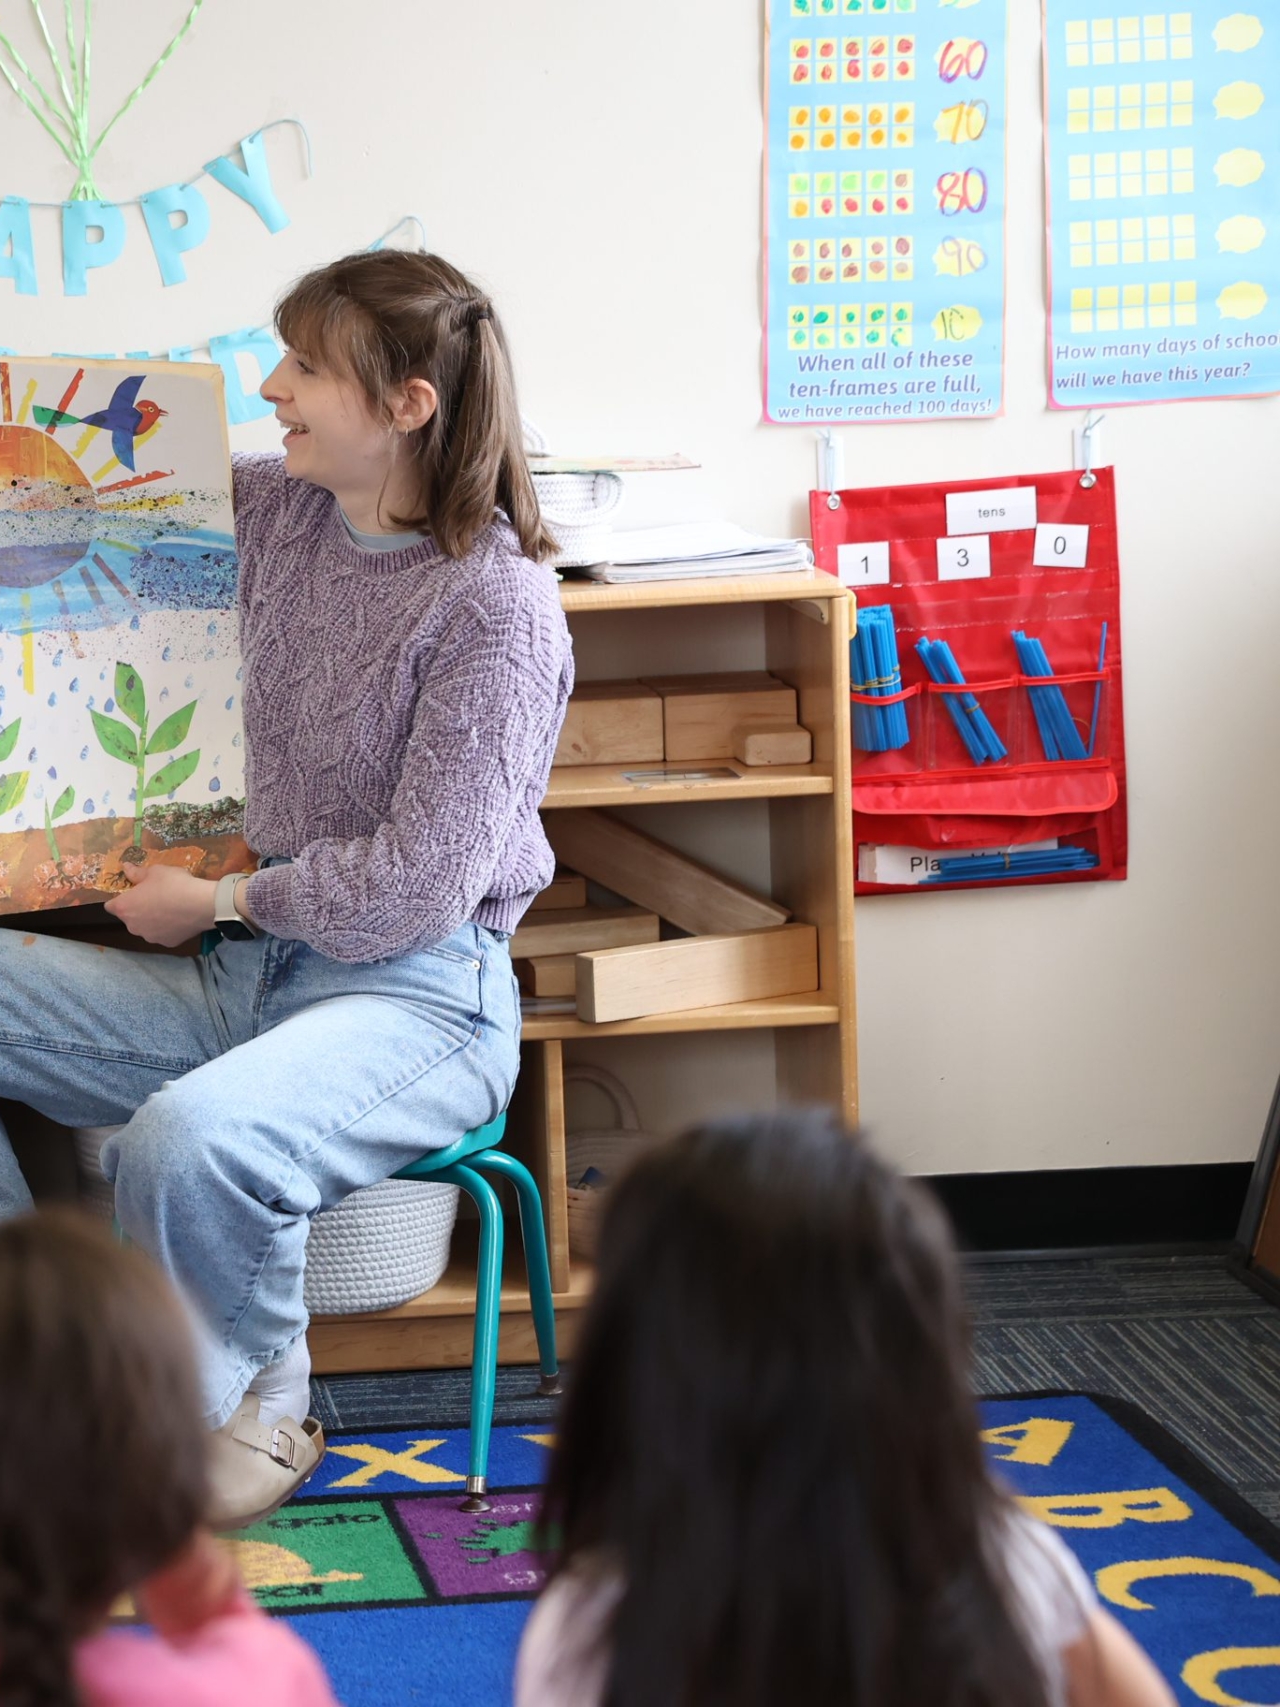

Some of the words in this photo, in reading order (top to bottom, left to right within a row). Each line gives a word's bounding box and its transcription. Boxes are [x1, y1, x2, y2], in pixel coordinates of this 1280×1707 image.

[938, 40, 988, 83] 60
[941, 98, 989, 145] 70
[937, 167, 988, 216] 80
[942, 235, 988, 277] 90
[798, 354, 855, 372] When
[861, 352, 886, 370] all
[893, 351, 913, 369] of
[919, 351, 973, 368] these
[1056, 346, 1097, 360] How
[1102, 343, 1151, 358] many
[1157, 338, 1196, 356] days
[1203, 334, 1221, 350] of
[1226, 332, 1280, 349] schoo
[789, 379, 898, 398] ten-frames
[904, 380, 936, 394] are
[943, 374, 981, 394] full,
[1056, 373, 1086, 388] will
[1092, 374, 1116, 386] we
[1121, 369, 1162, 385] have
[1168, 365, 1198, 381] this
[1204, 362, 1250, 382] year?
[778, 408, 800, 418] we
[805, 404, 842, 418] have
[848, 401, 912, 416] reached
[918, 399, 946, 414] 100
[950, 398, 992, 416] days!
[978, 508, 1006, 518] tens
[860, 556, 870, 574] 1
[956, 548, 971, 568] 3
[1052, 536, 1067, 556] 0
[326, 1439, 468, 1488] X
[1011, 1487, 1193, 1529] B
[1094, 1556, 1280, 1610] C
